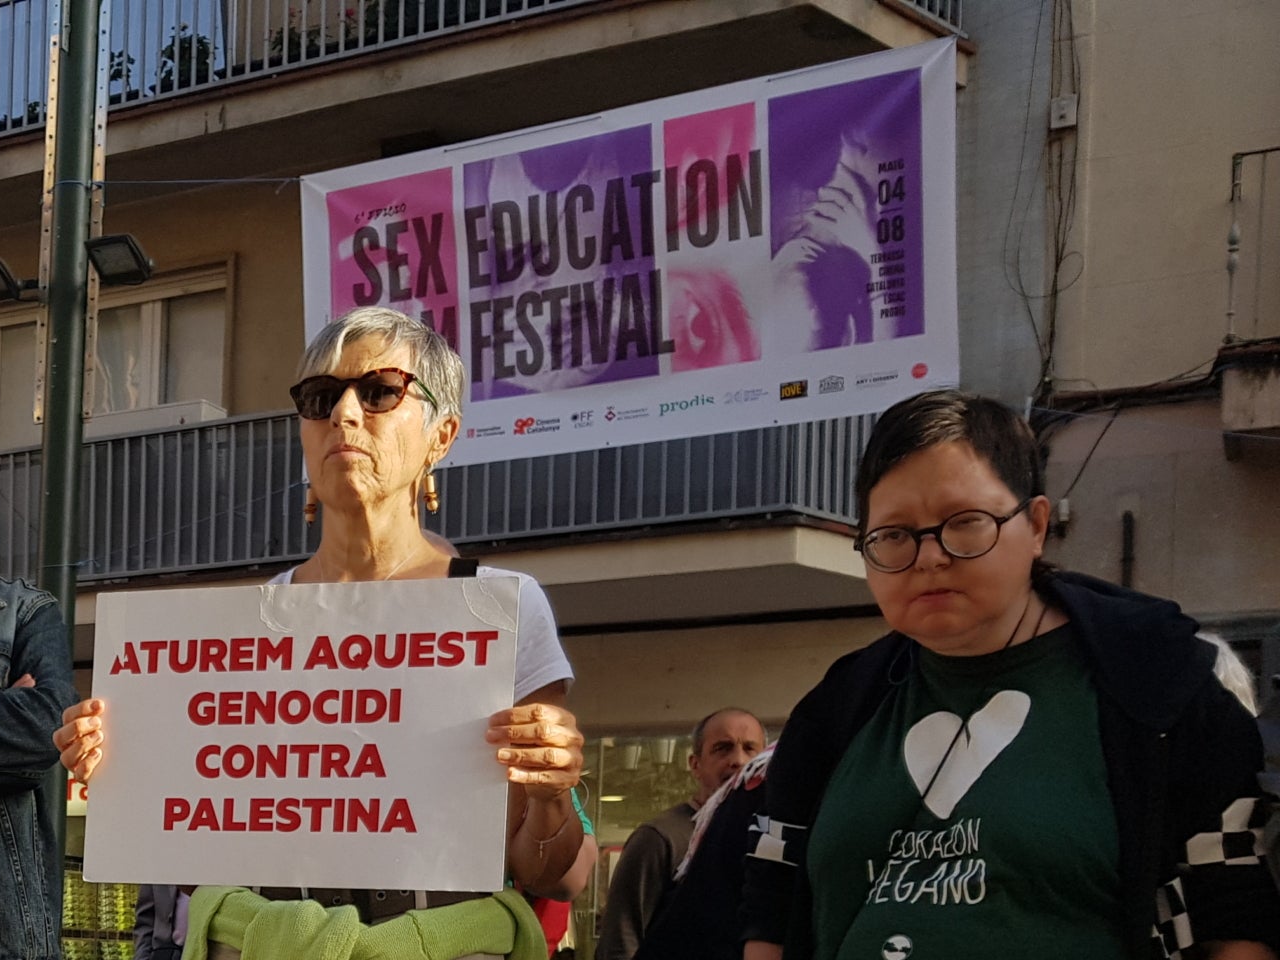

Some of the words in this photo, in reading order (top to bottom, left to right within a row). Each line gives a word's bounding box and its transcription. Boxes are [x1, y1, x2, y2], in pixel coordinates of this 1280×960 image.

[877, 175, 906, 206] 04
[352, 212, 449, 307] SEX
[464, 149, 763, 289] EDUCATION
[876, 214, 906, 245] 08
[470, 268, 676, 383] FESTIVAL
[110, 636, 293, 675] ATUREM
[303, 630, 499, 672] AQUEST
[187, 688, 402, 726] GENOCIDI
[195, 743, 387, 779] CONTRA
[163, 797, 417, 833] PALESTINA
[866, 858, 986, 905] VEGANO
